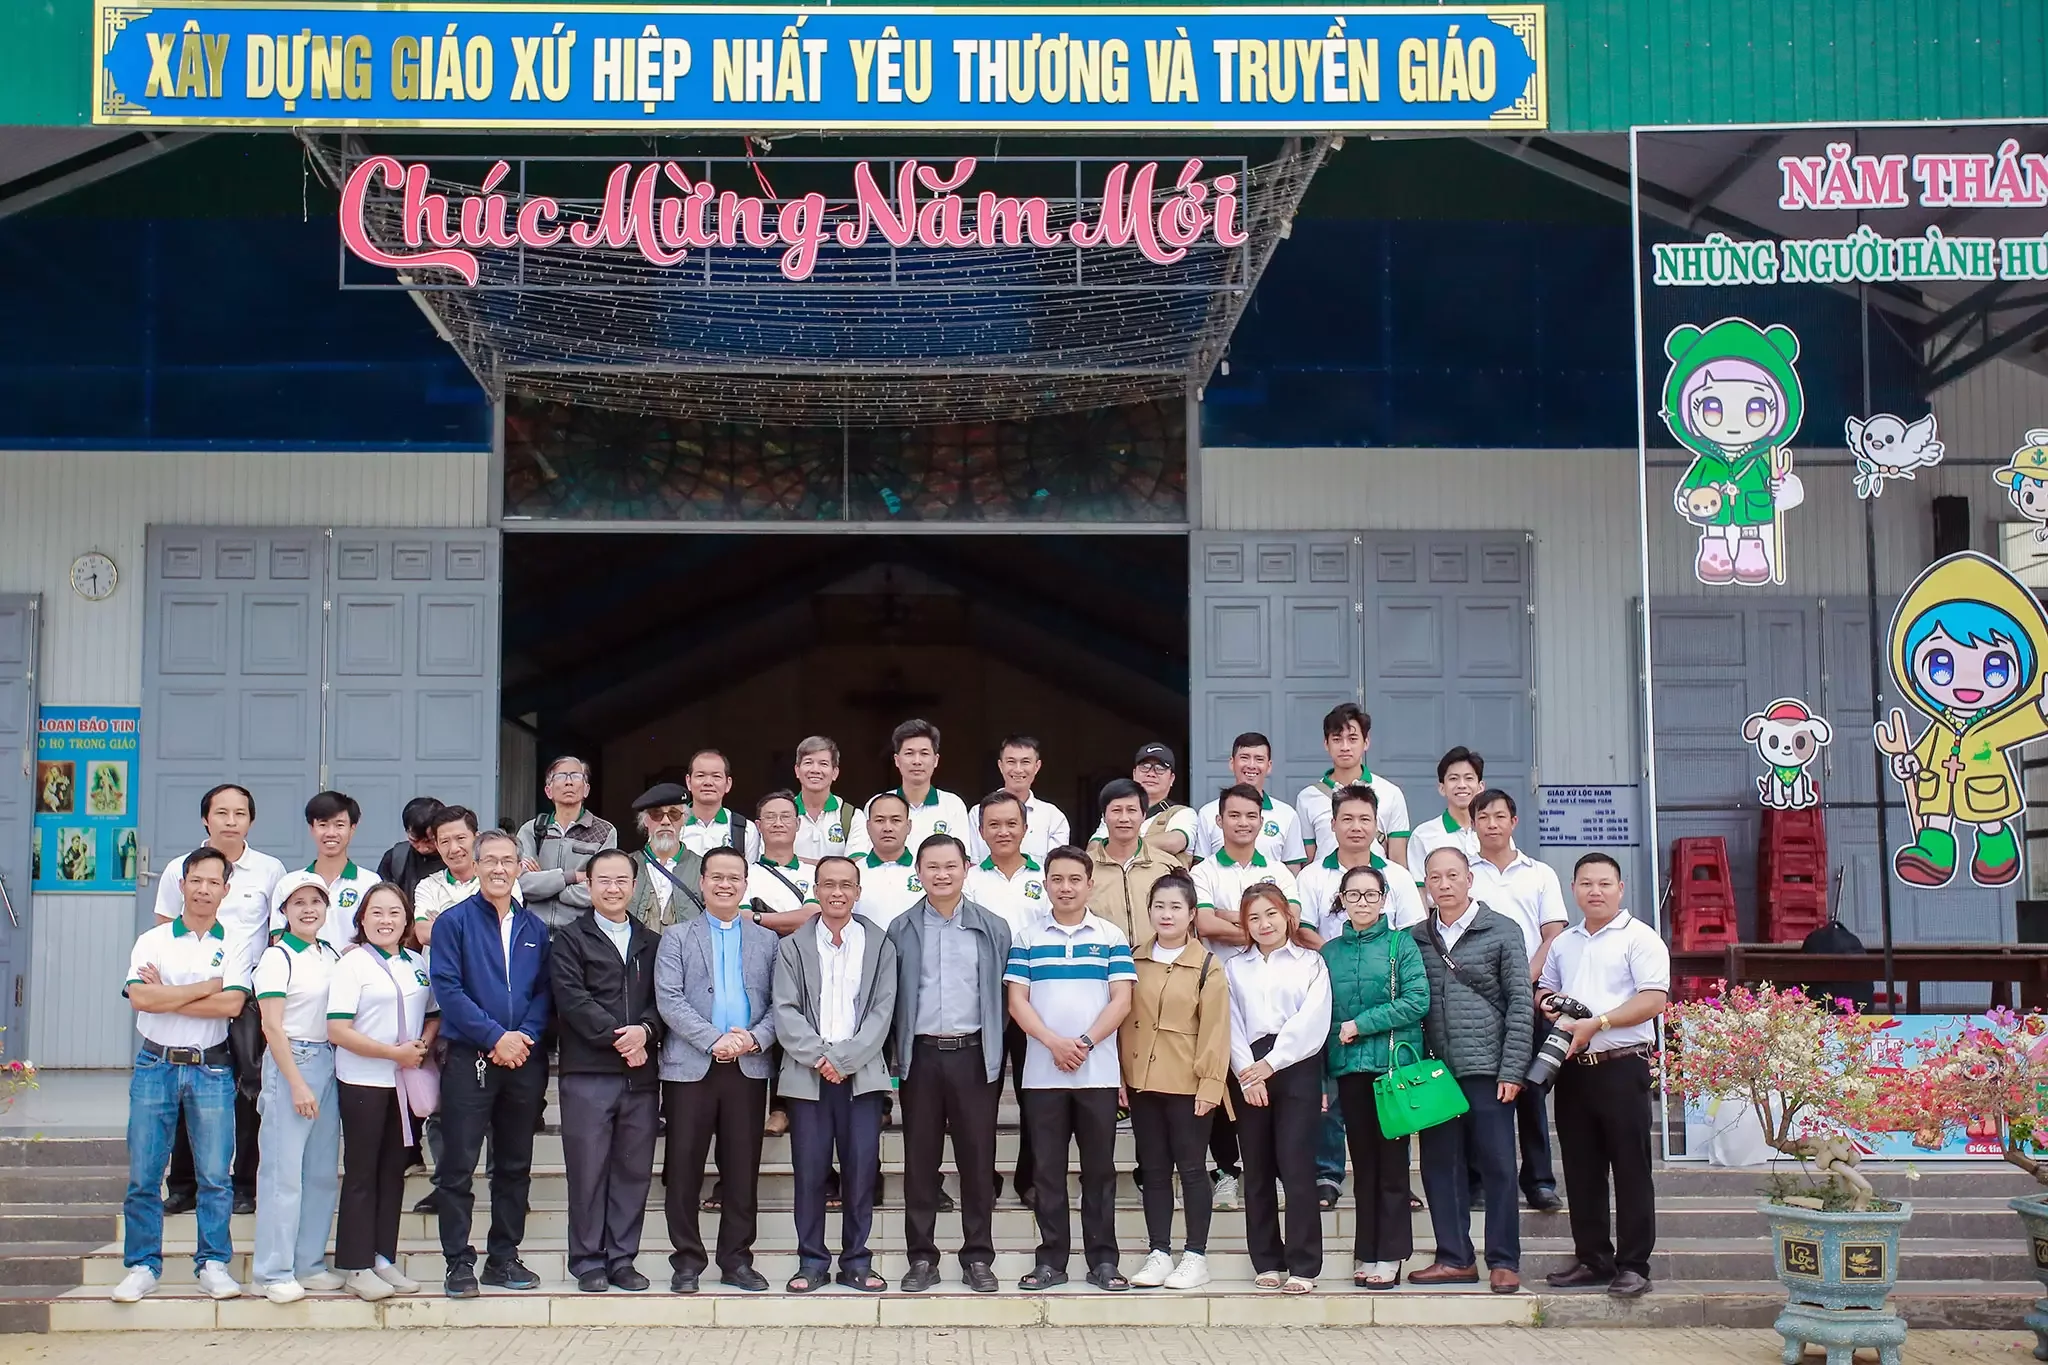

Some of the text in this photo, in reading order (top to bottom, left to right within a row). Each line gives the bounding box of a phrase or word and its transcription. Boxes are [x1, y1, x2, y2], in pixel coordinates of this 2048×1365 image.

[145, 15, 1496, 113] XÂY DỰNG GIÁO XỨ HIỆP NHẤT YÊU THƯƠNG VÀ TRUYỀN GIÁO
[1781, 145, 1906, 208] NĂM
[339, 156, 1250, 288] Chúc Mừng Năm Mới
[1655, 235, 1777, 282] NHỮNG
[1784, 228, 1895, 280] NGƯỜI
[1900, 229, 1994, 278] HÀNH
[69, 738, 106, 749] TRONG
[110, 736, 136, 749] GIÁO
[78, 716, 108, 732] BÁO
[111, 719, 135, 732] TIN
[1547, 789, 1565, 797] GIÁO
[1578, 789, 1592, 798] LỘC
